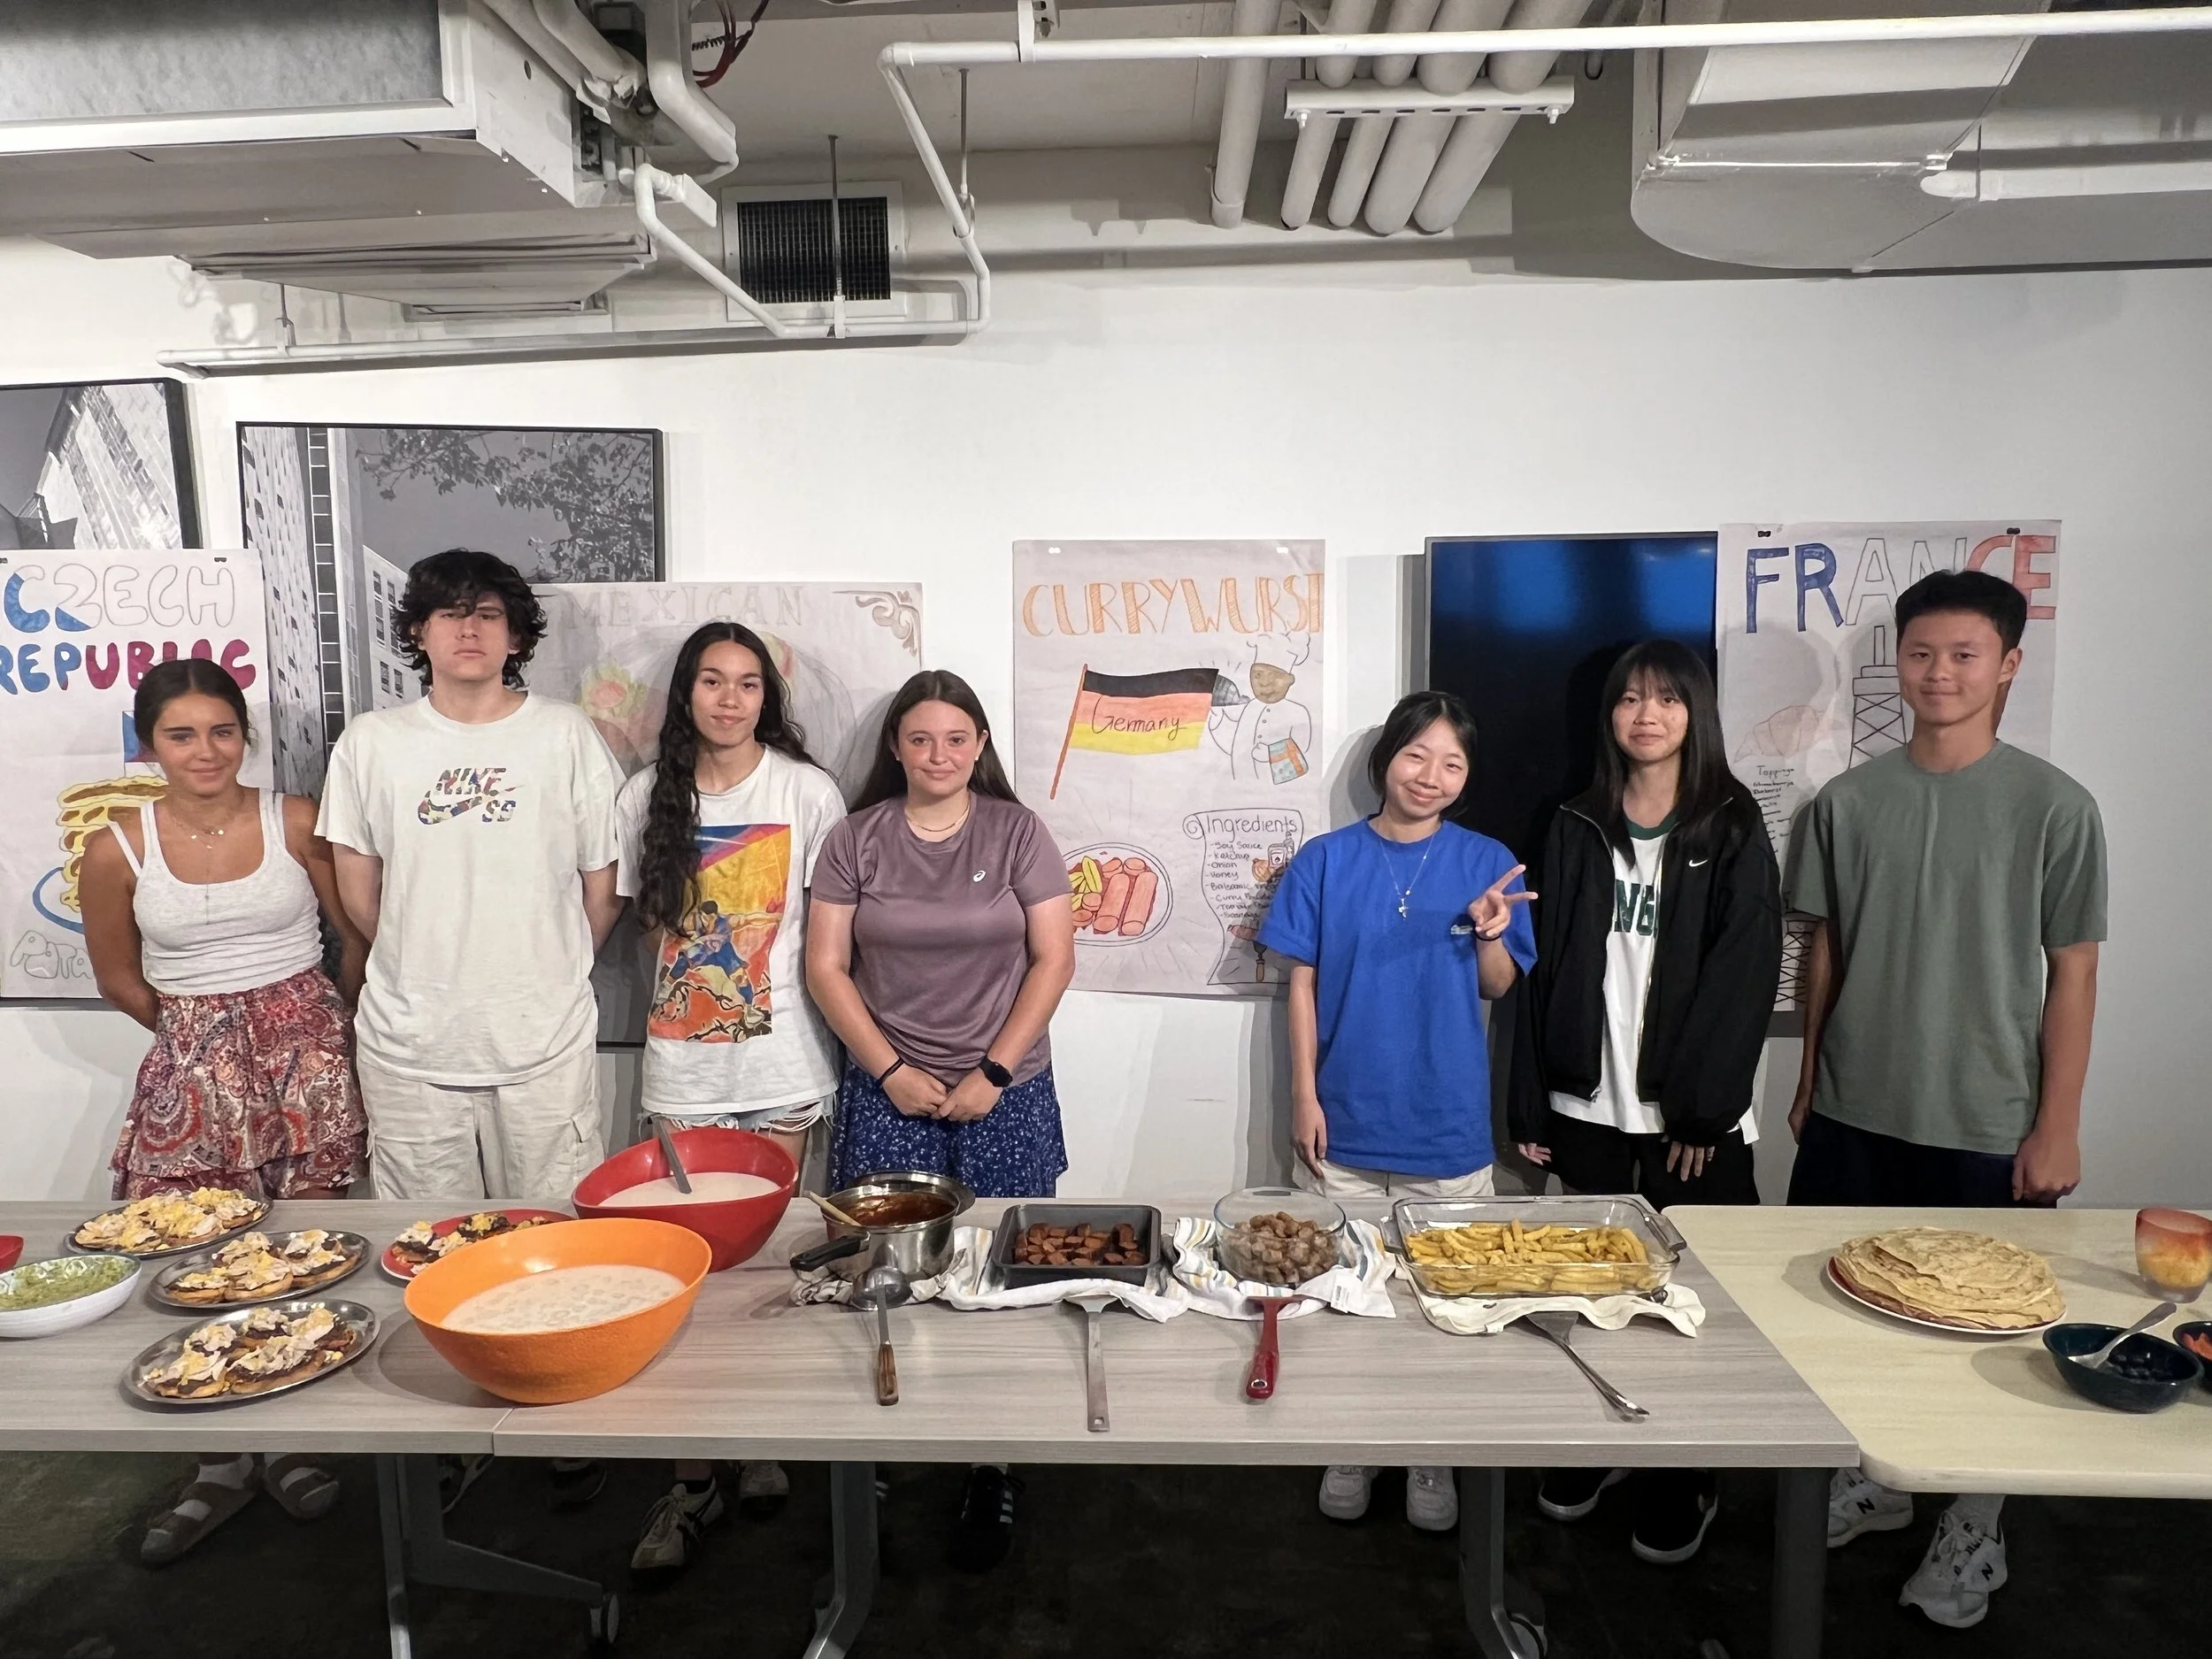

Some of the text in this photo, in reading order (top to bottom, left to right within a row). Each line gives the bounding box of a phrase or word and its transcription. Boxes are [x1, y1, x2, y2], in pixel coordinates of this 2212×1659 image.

[4, 563, 235, 634] CZECH
[566, 585, 806, 627] MEXICAN
[1091, 695, 1187, 741] Germany
[437, 767, 507, 795] NIKE
[1206, 814, 1298, 842] Ingredients
